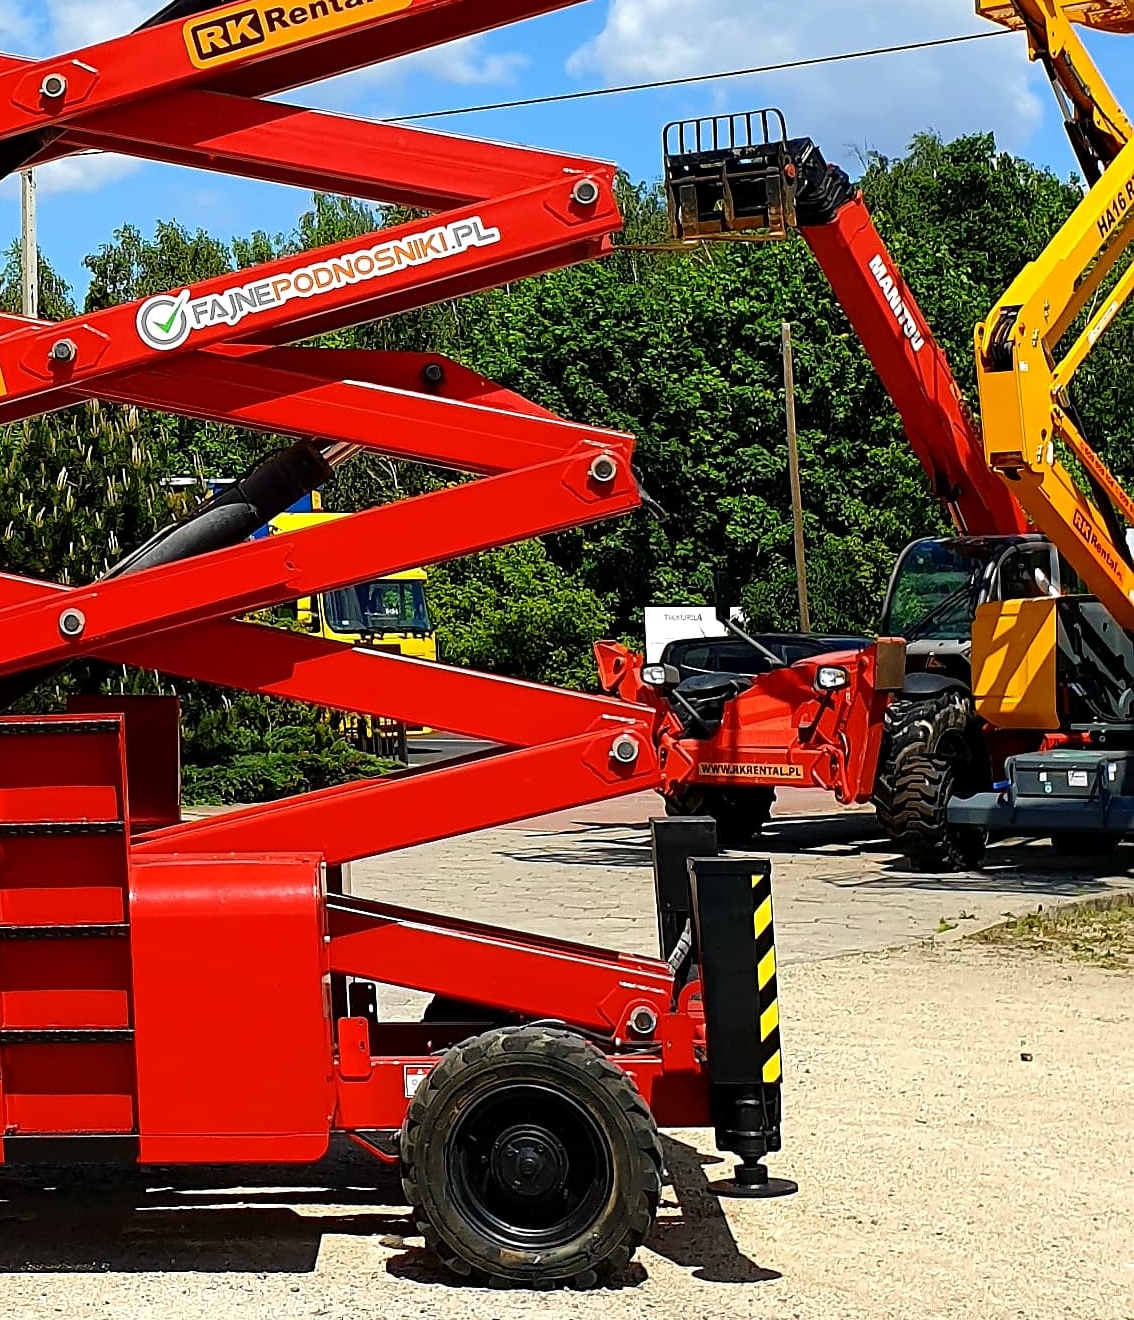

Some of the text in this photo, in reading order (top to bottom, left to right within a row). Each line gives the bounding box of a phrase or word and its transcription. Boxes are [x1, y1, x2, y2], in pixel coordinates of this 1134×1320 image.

[196, 13, 261, 54] RK
[1097, 192, 1126, 238] HA16
[192, 221, 495, 324] FAJNEPODNOSNIKI.PL
[869, 254, 924, 351] MANITOU
[701, 763, 801, 777] WWW.RKRENTAL.PL
